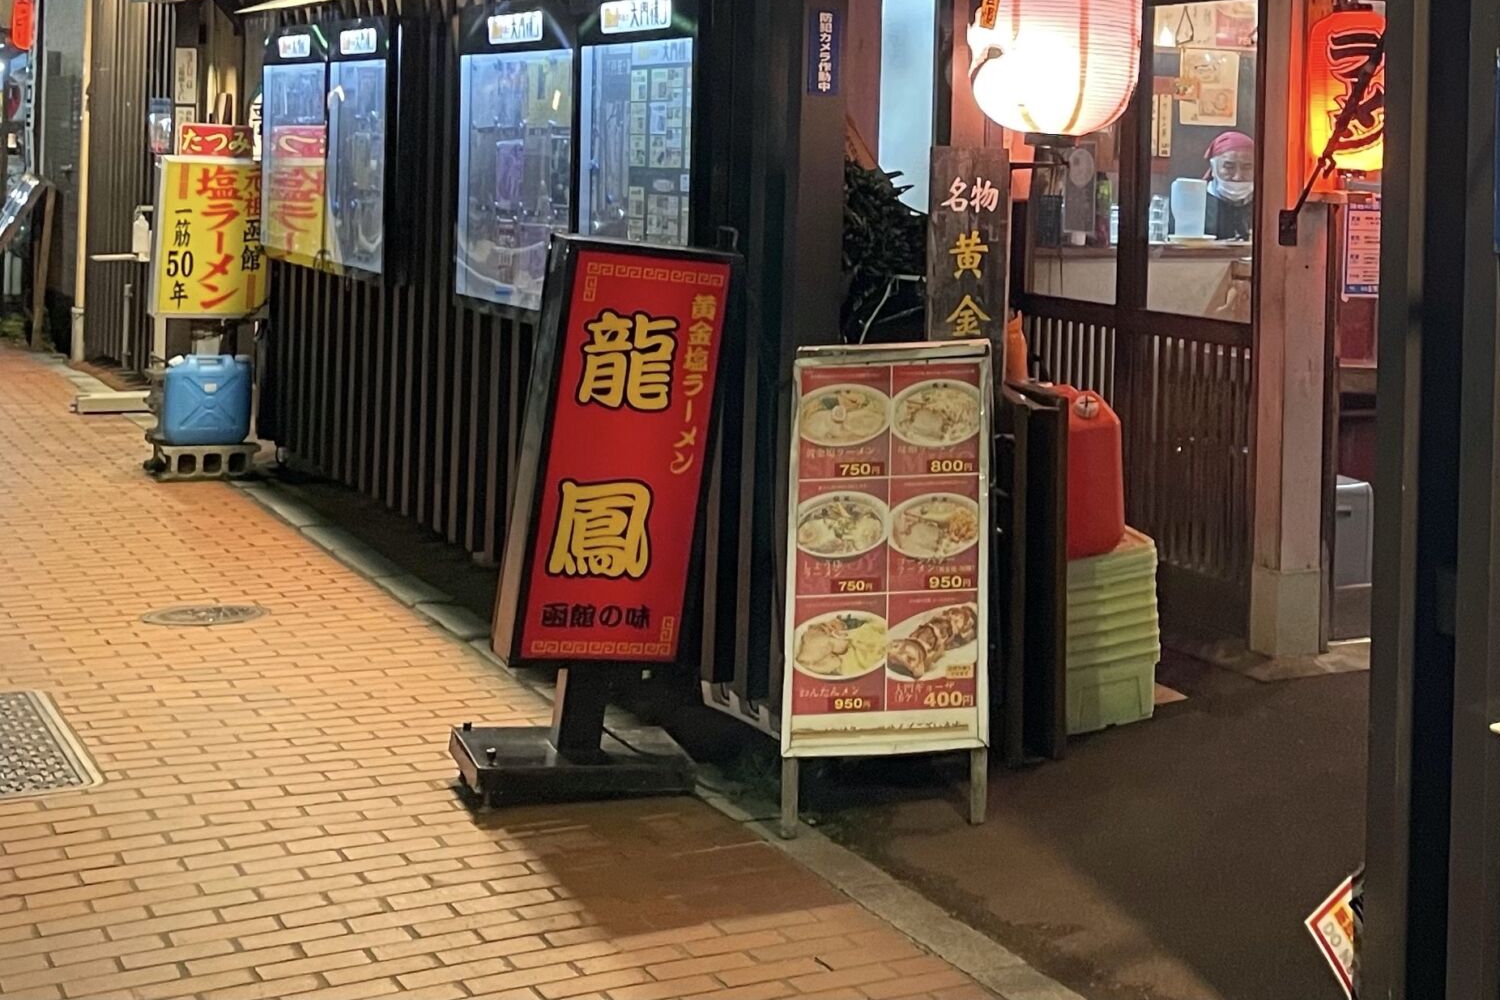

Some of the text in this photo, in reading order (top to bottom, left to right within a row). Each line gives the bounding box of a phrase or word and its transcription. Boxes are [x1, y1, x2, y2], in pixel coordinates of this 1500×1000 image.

[817, 11, 834, 93] 防犯カメラ作動中
[181, 128, 250, 154] たつみ
[941, 176, 1000, 214] 名物
[196, 165, 241, 310] 塩ラーメン
[166, 208, 194, 310] 一筋50年
[946, 230, 992, 338] 黄金
[670, 292, 718, 475] 黄金塩ラーメン
[547, 309, 679, 579] 龍鳳
[839, 463, 881, 477] 750円
[930, 460, 973, 473] 800円
[838, 580, 873, 592] 750円
[928, 575, 973, 589] 950円
[541, 602, 651, 630] 函館の味
[834, 698, 871, 710] 950円
[923, 691, 974, 708] 400円
